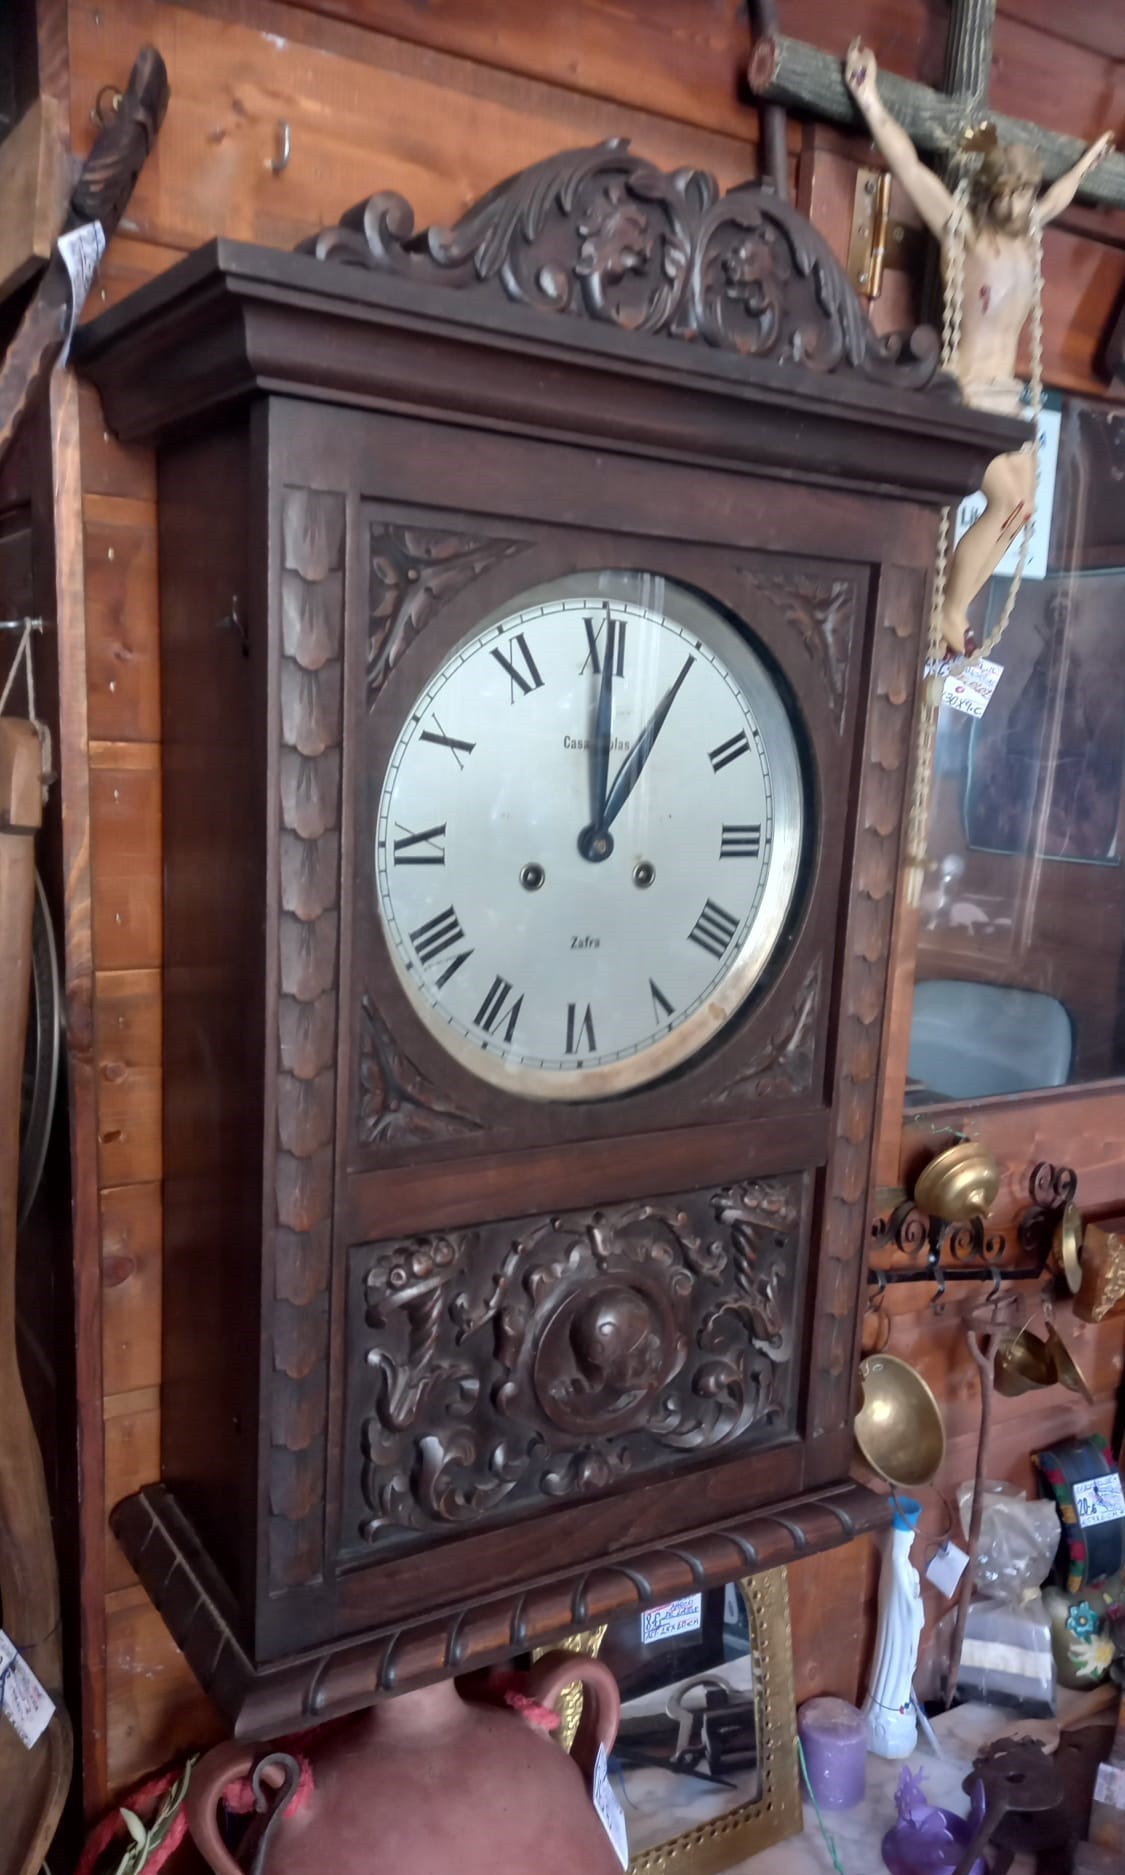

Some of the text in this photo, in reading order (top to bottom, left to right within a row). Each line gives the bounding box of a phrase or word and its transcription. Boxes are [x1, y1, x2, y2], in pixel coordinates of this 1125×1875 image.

[490, 633, 545, 704] XI
[579, 617, 628, 678] XII
[420, 713, 476, 770] X
[563, 735, 590, 750] Casa
[707, 729, 751, 773] II
[394, 822, 447, 866] IX
[720, 824, 761, 859] III
[409, 905, 475, 989] VIII
[569, 935, 601, 951] Zafra
[688, 898, 741, 960] IIII
[472, 975, 524, 1043] VII
[649, 978, 676, 1024] V
[565, 1003, 597, 1055] VI
